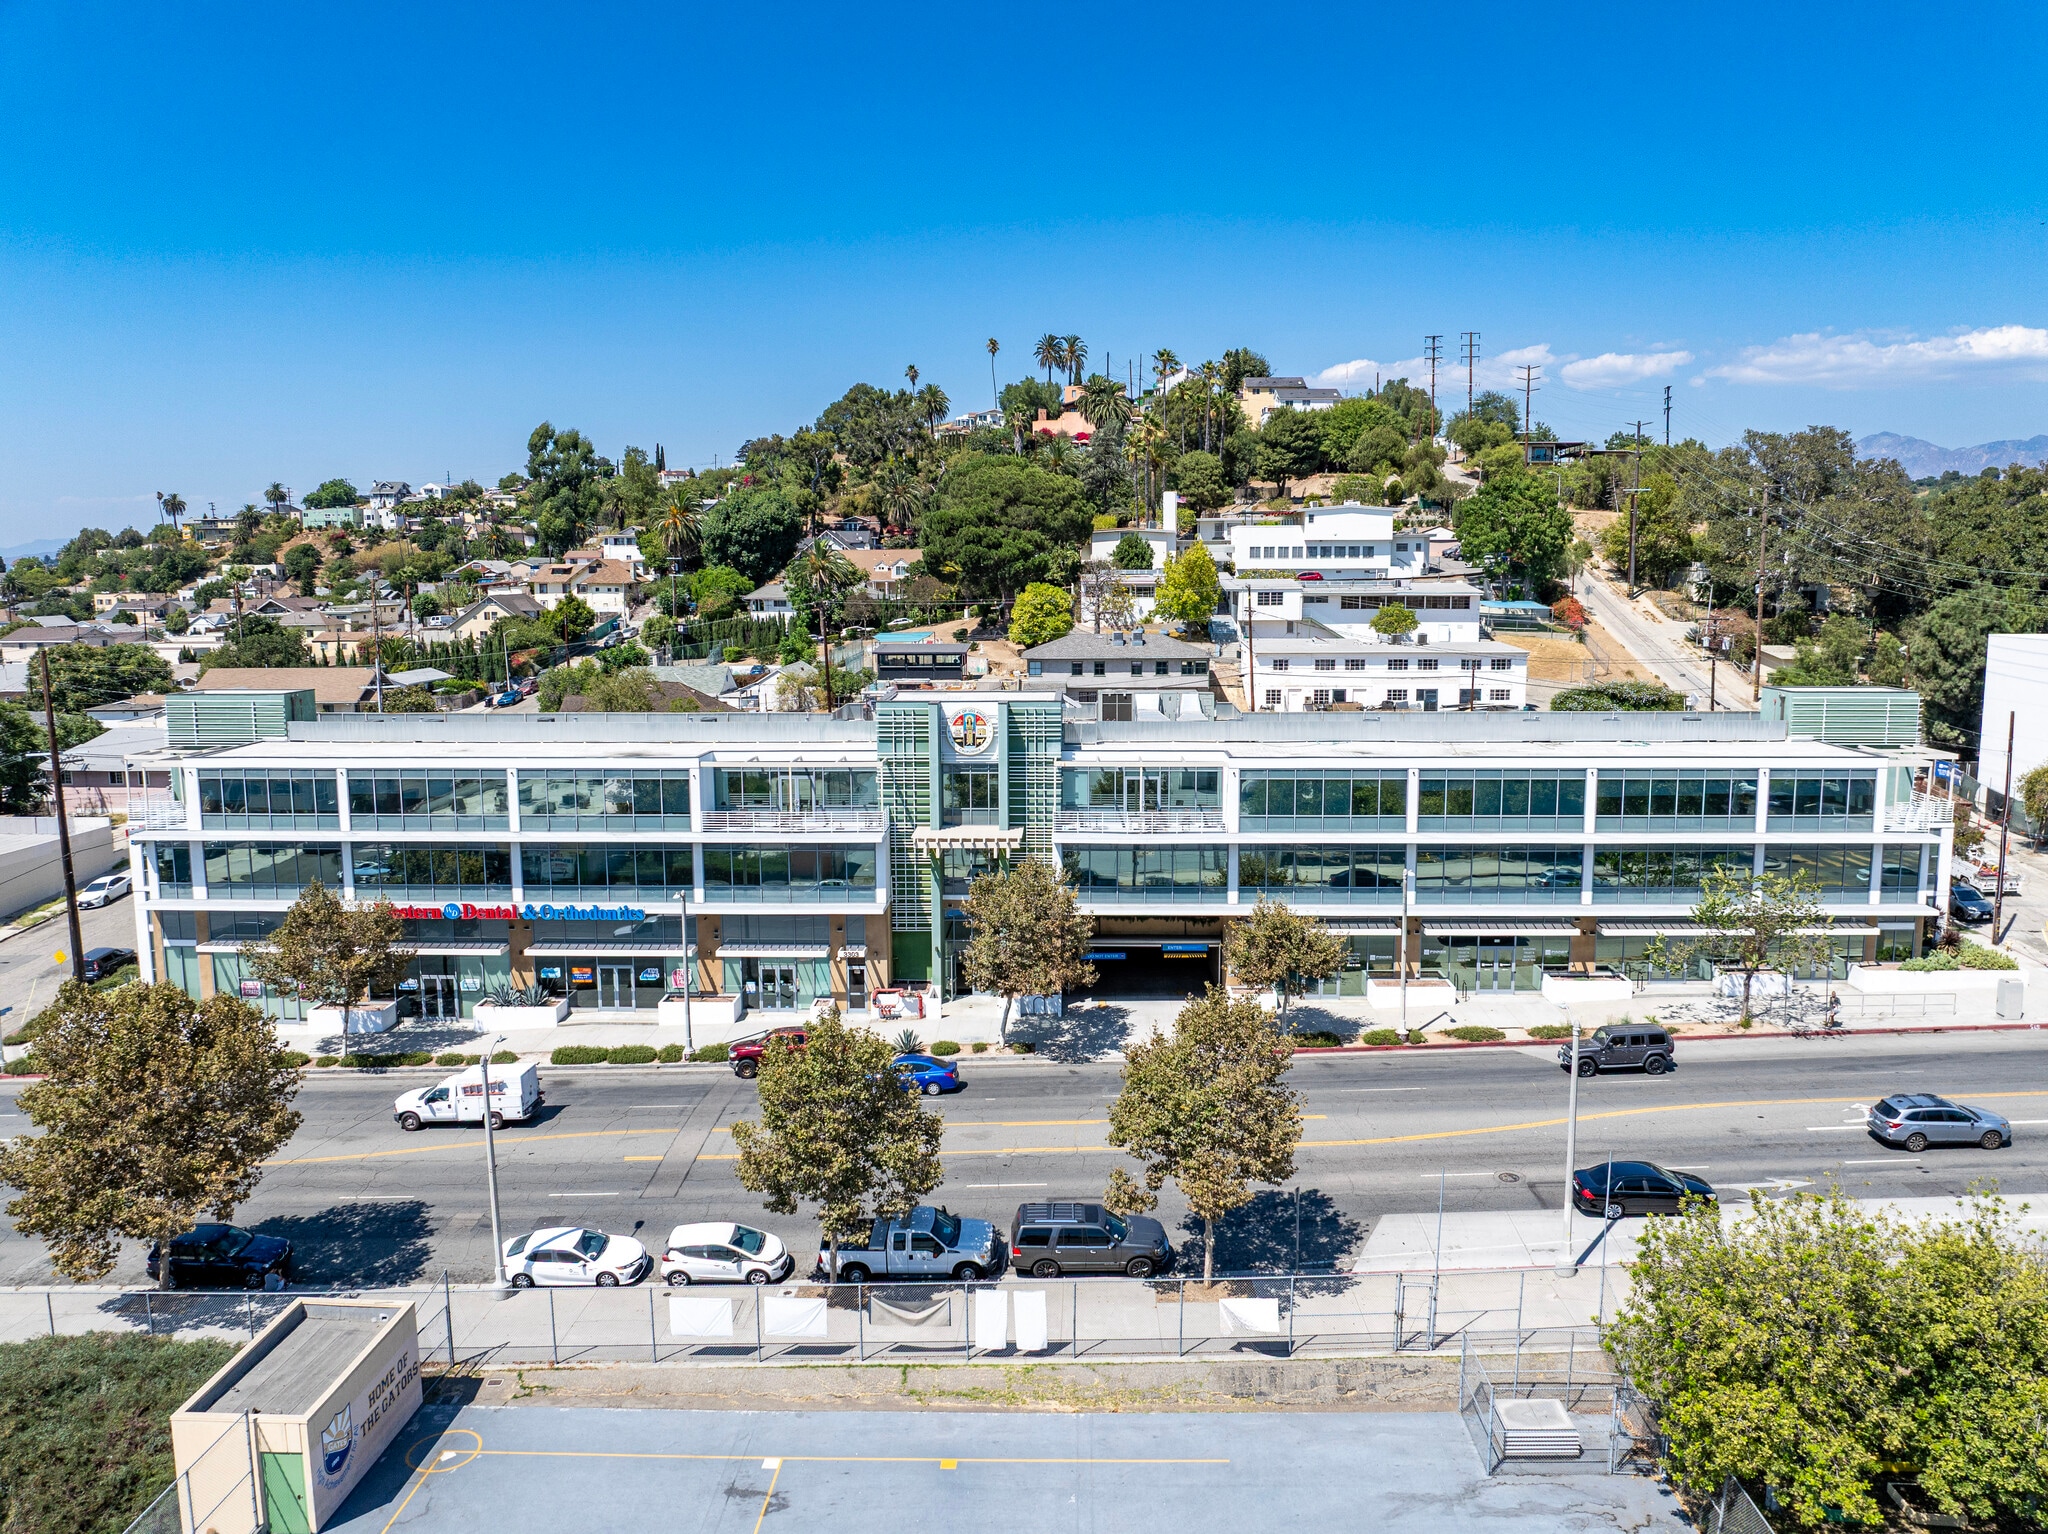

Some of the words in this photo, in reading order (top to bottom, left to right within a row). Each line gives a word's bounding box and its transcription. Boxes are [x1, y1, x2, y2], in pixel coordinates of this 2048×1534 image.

[461, 903, 518, 920] Dental
[522, 904, 537, 920] &
[539, 904, 645, 921] Orthodontics
[360, 1406, 381, 1438] THE
[381, 1361, 419, 1414] GATORS
[367, 1367, 396, 1409] HOME
[396, 1352, 409, 1375] OF
